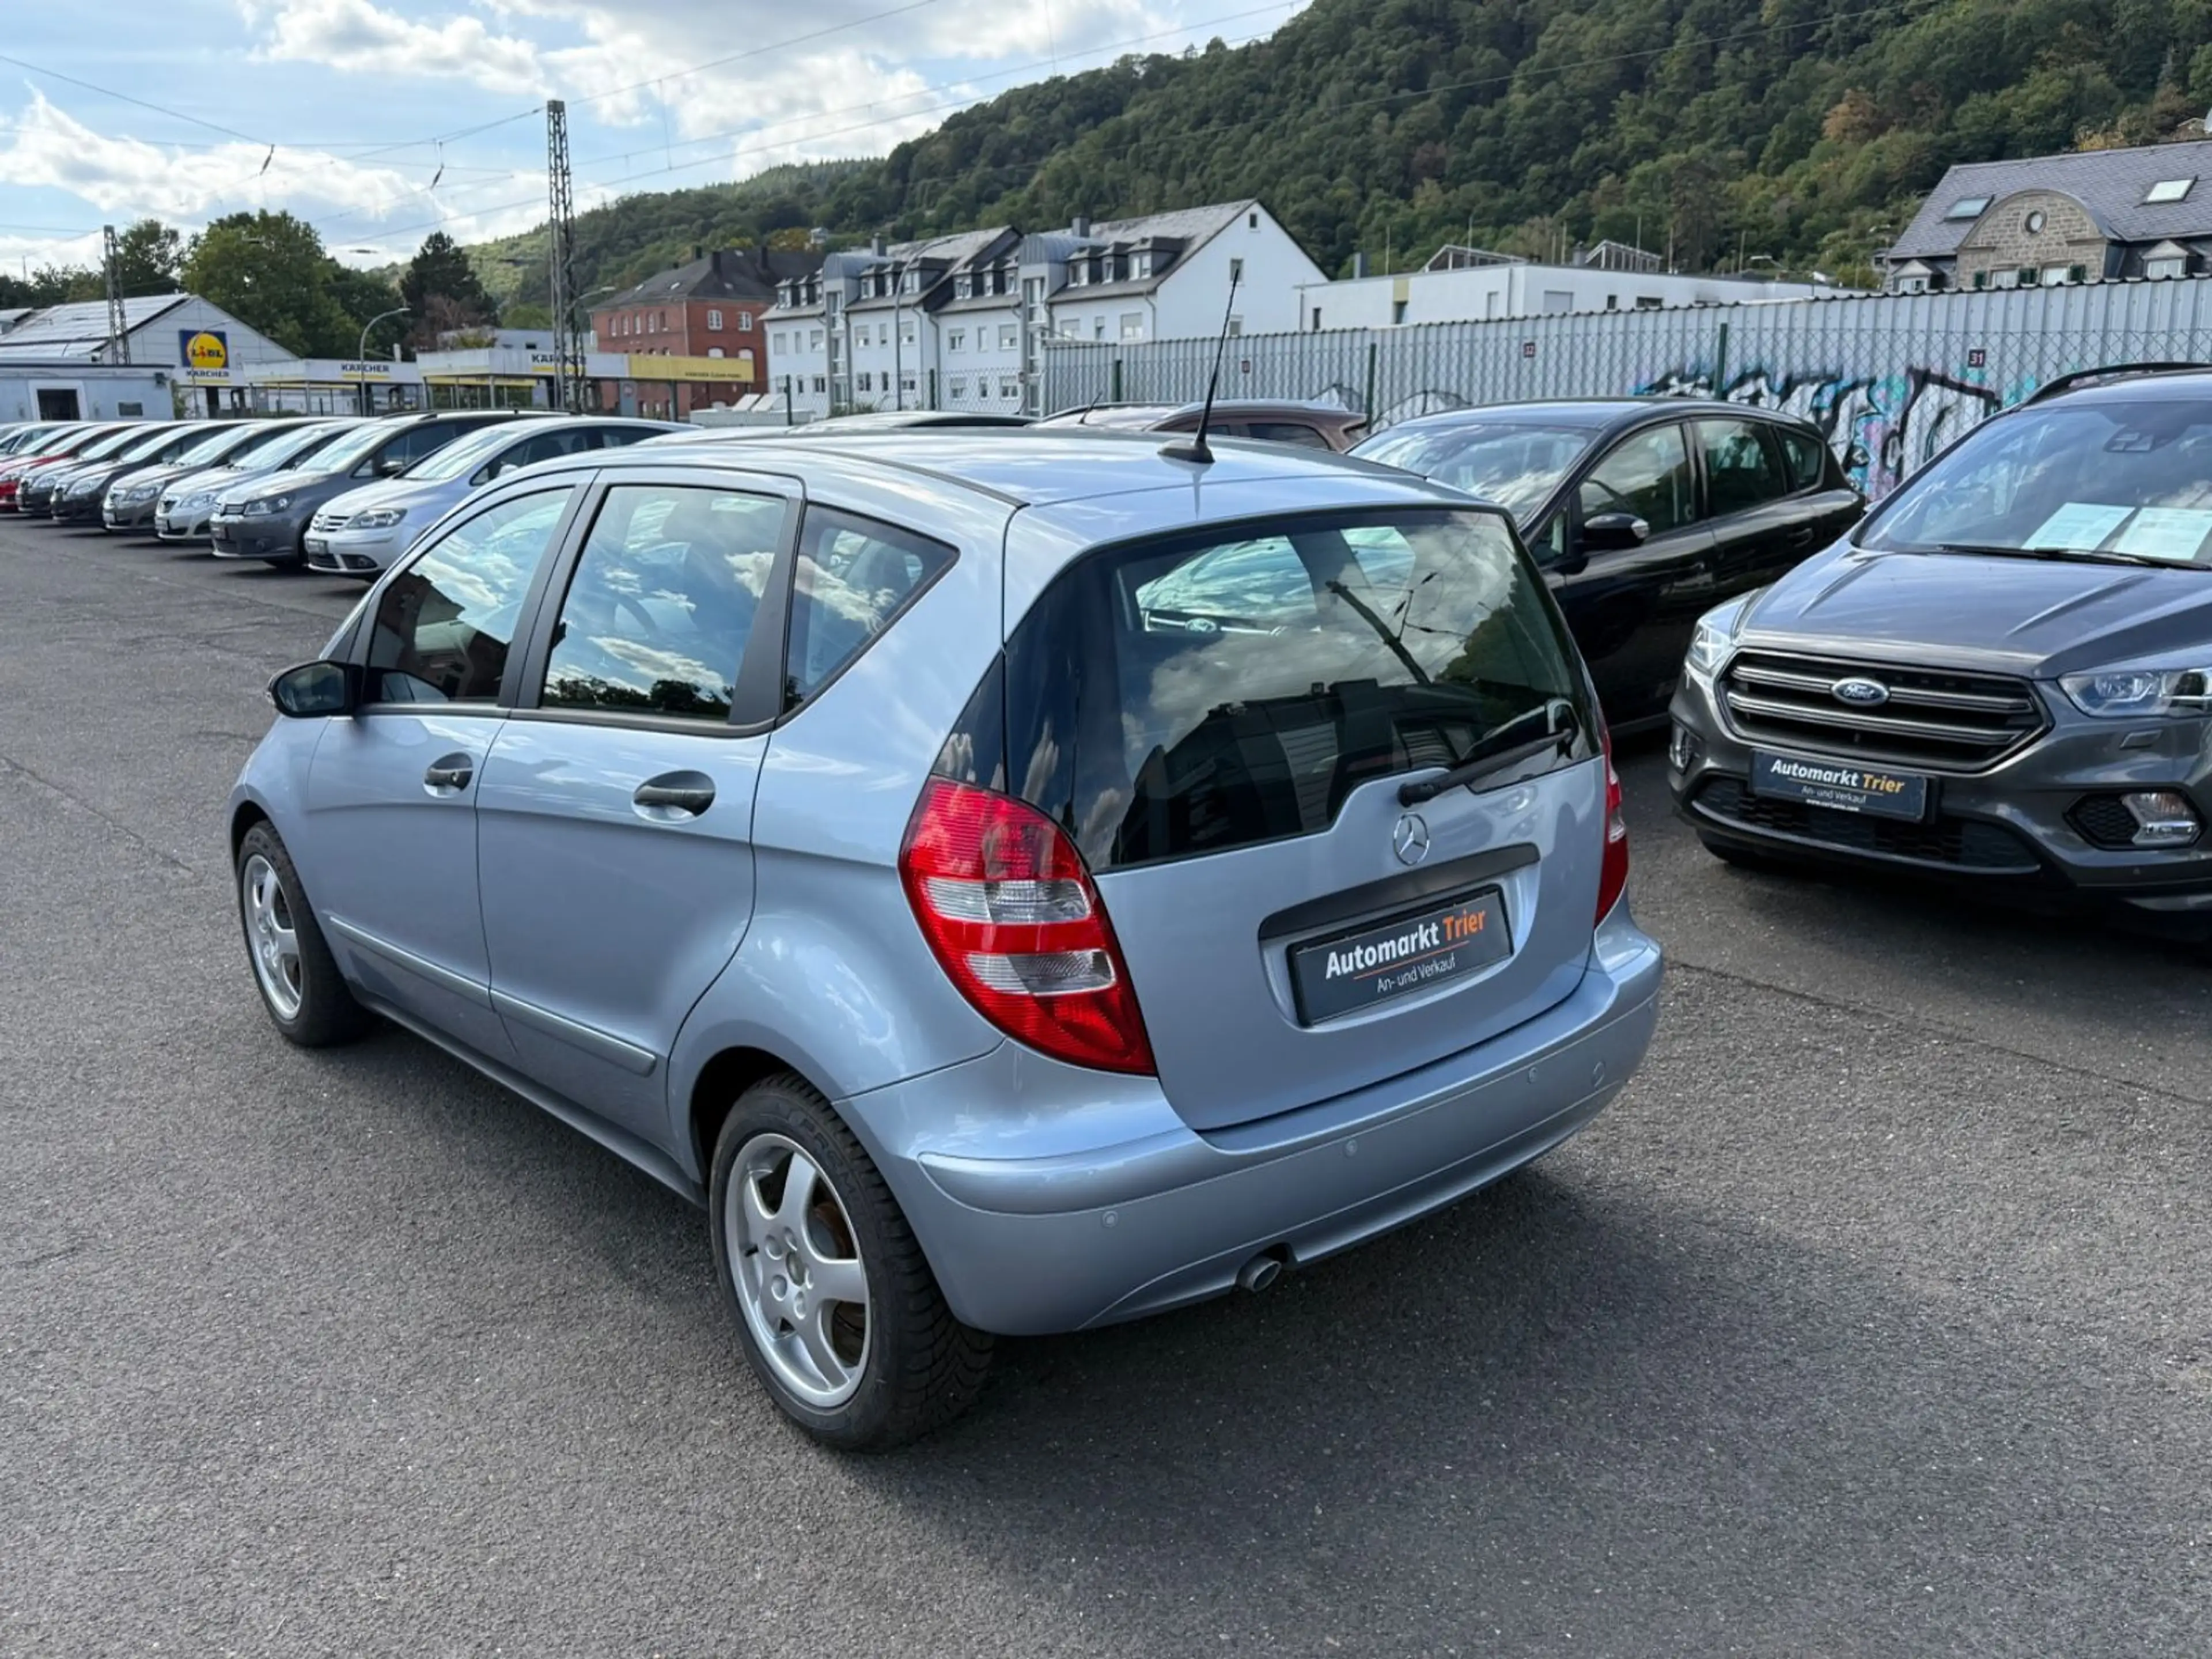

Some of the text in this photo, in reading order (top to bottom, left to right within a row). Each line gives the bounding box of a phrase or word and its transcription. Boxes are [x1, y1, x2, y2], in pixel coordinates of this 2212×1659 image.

[1970, 352, 1983, 364] 31
[1844, 683, 1875, 699] Ford
[1770, 759, 1904, 793] Automarkt Trier
[1801, 785, 1866, 804] An- und Verkauf
[1325, 908, 1486, 979] Automarkt Trier
[1377, 952, 1456, 993] An- und Verkauf
